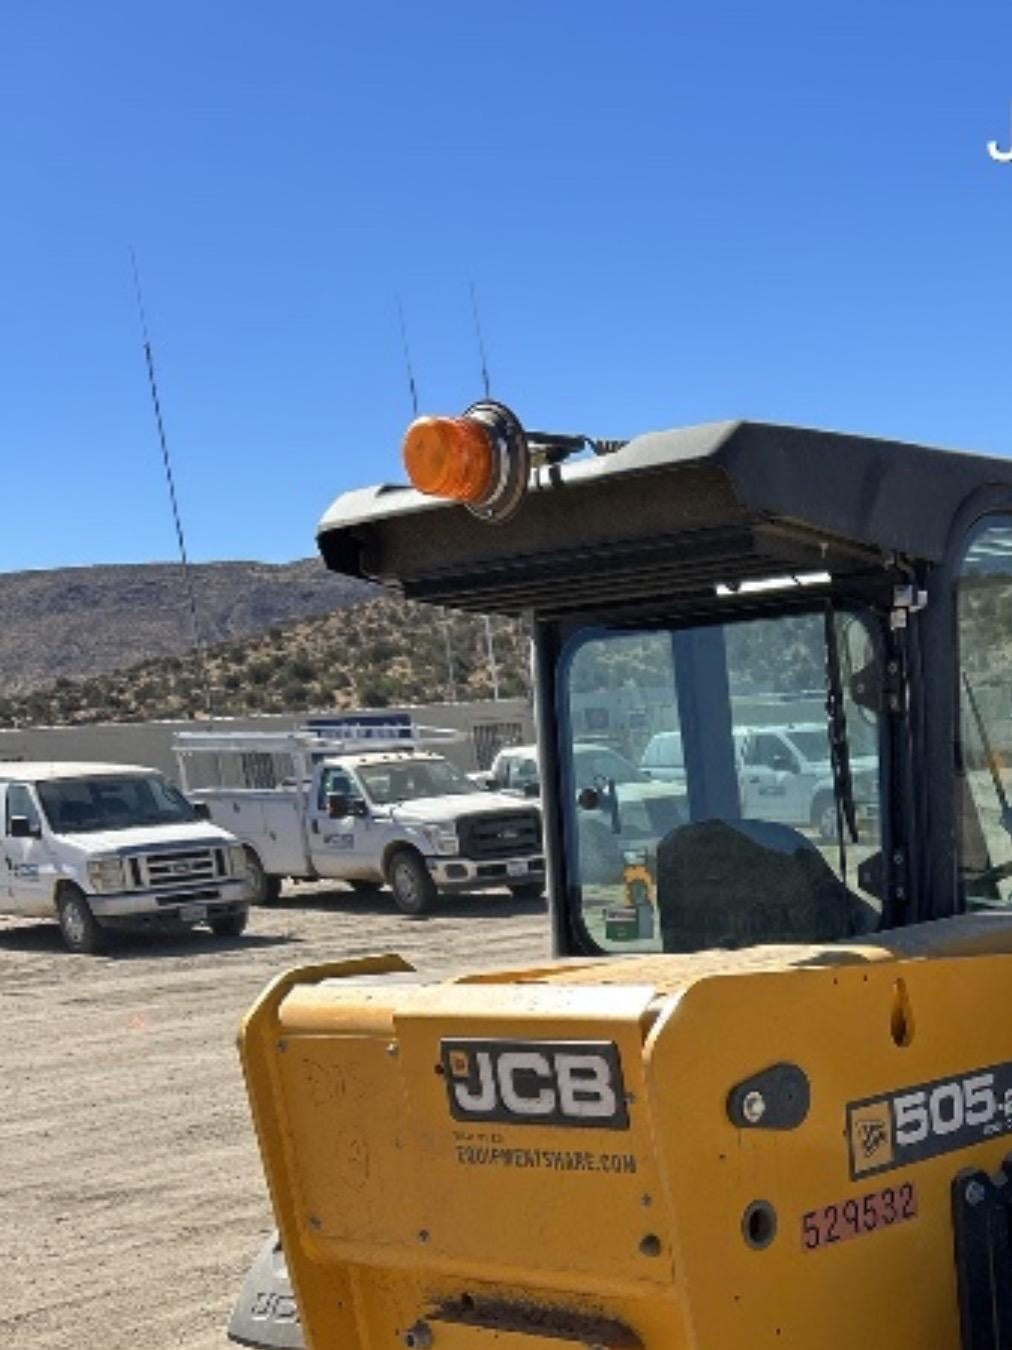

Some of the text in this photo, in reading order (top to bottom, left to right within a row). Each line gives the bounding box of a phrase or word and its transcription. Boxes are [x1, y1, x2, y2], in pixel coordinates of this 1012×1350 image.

[454, 1051, 616, 1117] JCB
[803, 1182, 916, 1249] 529532
[250, 1291, 298, 1318] JC
